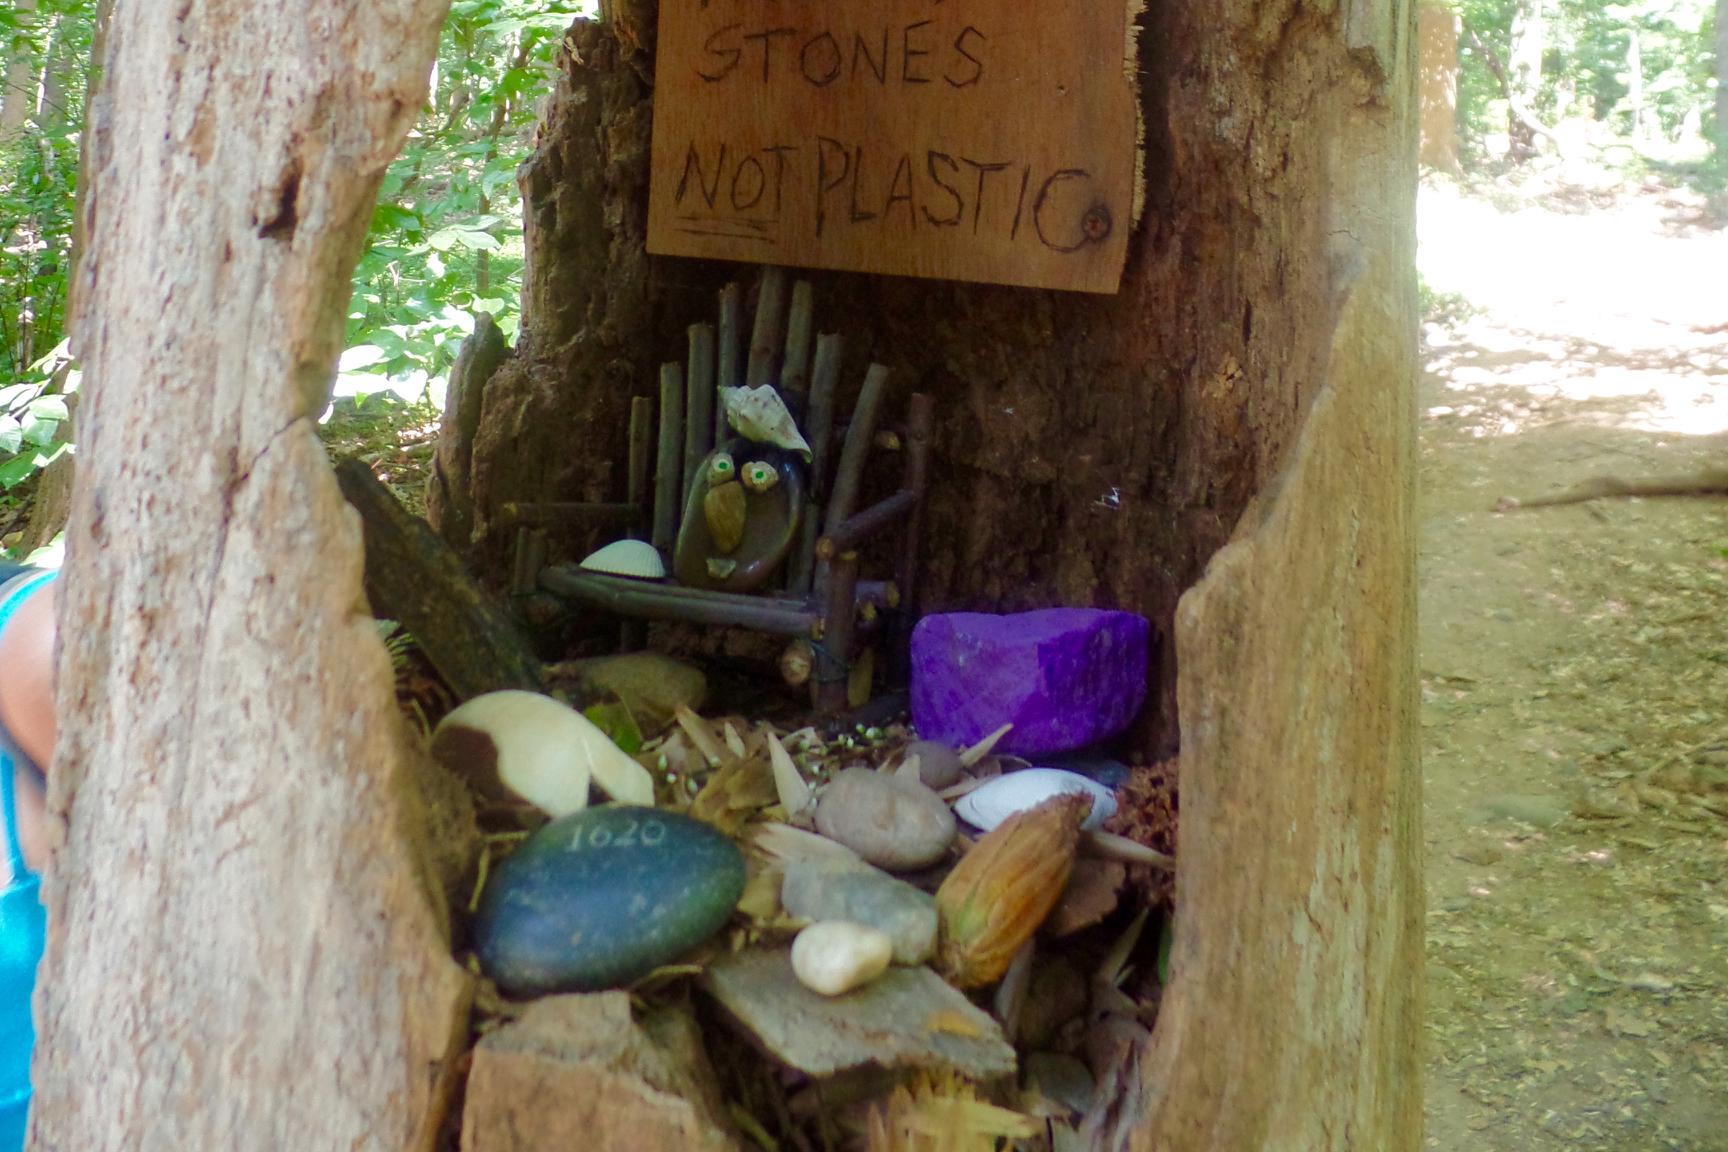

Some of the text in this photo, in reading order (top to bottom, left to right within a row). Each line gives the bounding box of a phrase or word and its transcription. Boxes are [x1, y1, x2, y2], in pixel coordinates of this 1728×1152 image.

[698, 20, 985, 88] STONES
[675, 136, 1111, 253] NOT PLASTIC
[569, 820, 666, 851] 1620
